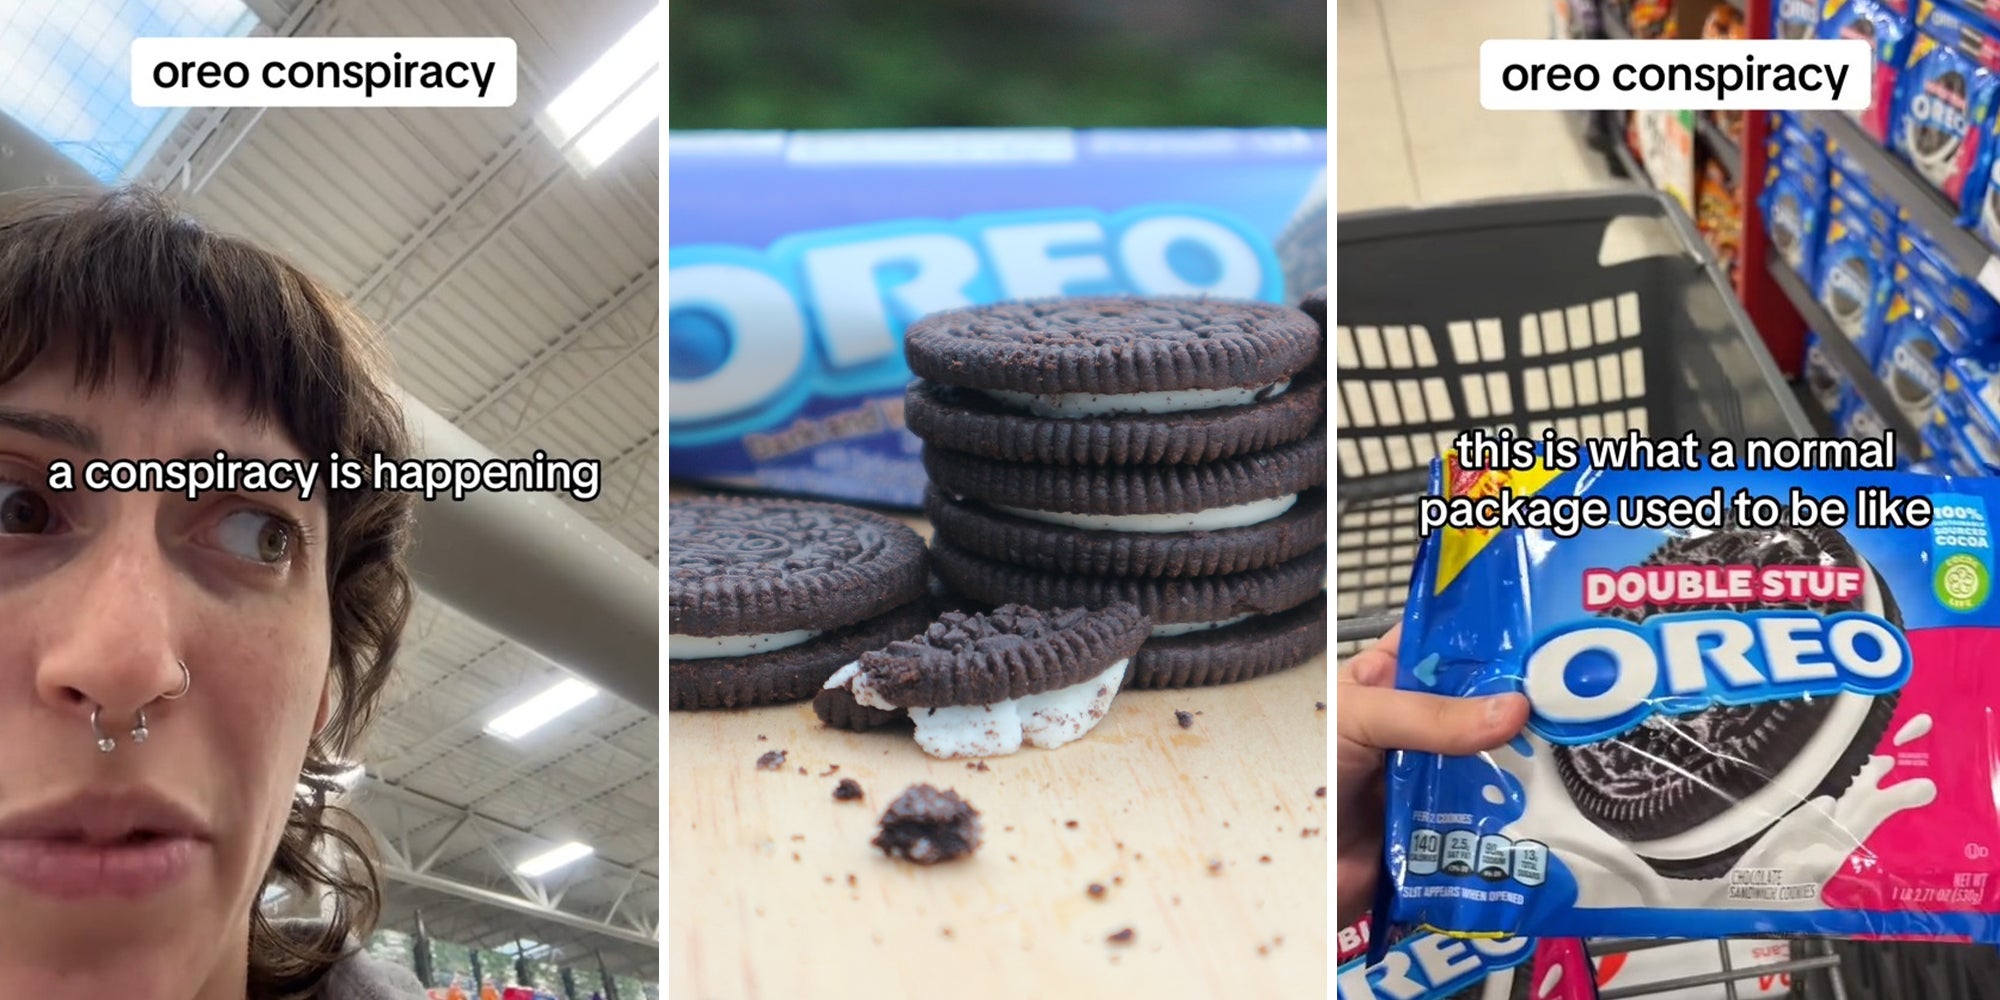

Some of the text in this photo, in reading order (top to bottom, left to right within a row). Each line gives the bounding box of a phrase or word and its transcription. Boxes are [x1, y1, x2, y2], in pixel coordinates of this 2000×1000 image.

[668, 215, 1264, 422] OREO
[1935, 535, 1989, 549] COCOA
[1586, 569, 1860, 606] DOUBLE STUF
[1523, 618, 1903, 724] OREO
[1413, 835, 1438, 853] 140
[1731, 868, 1784, 886] CHOCOLATE
[1423, 886, 1461, 898] APPEARS
[1461, 887, 1488, 902] WHEN
